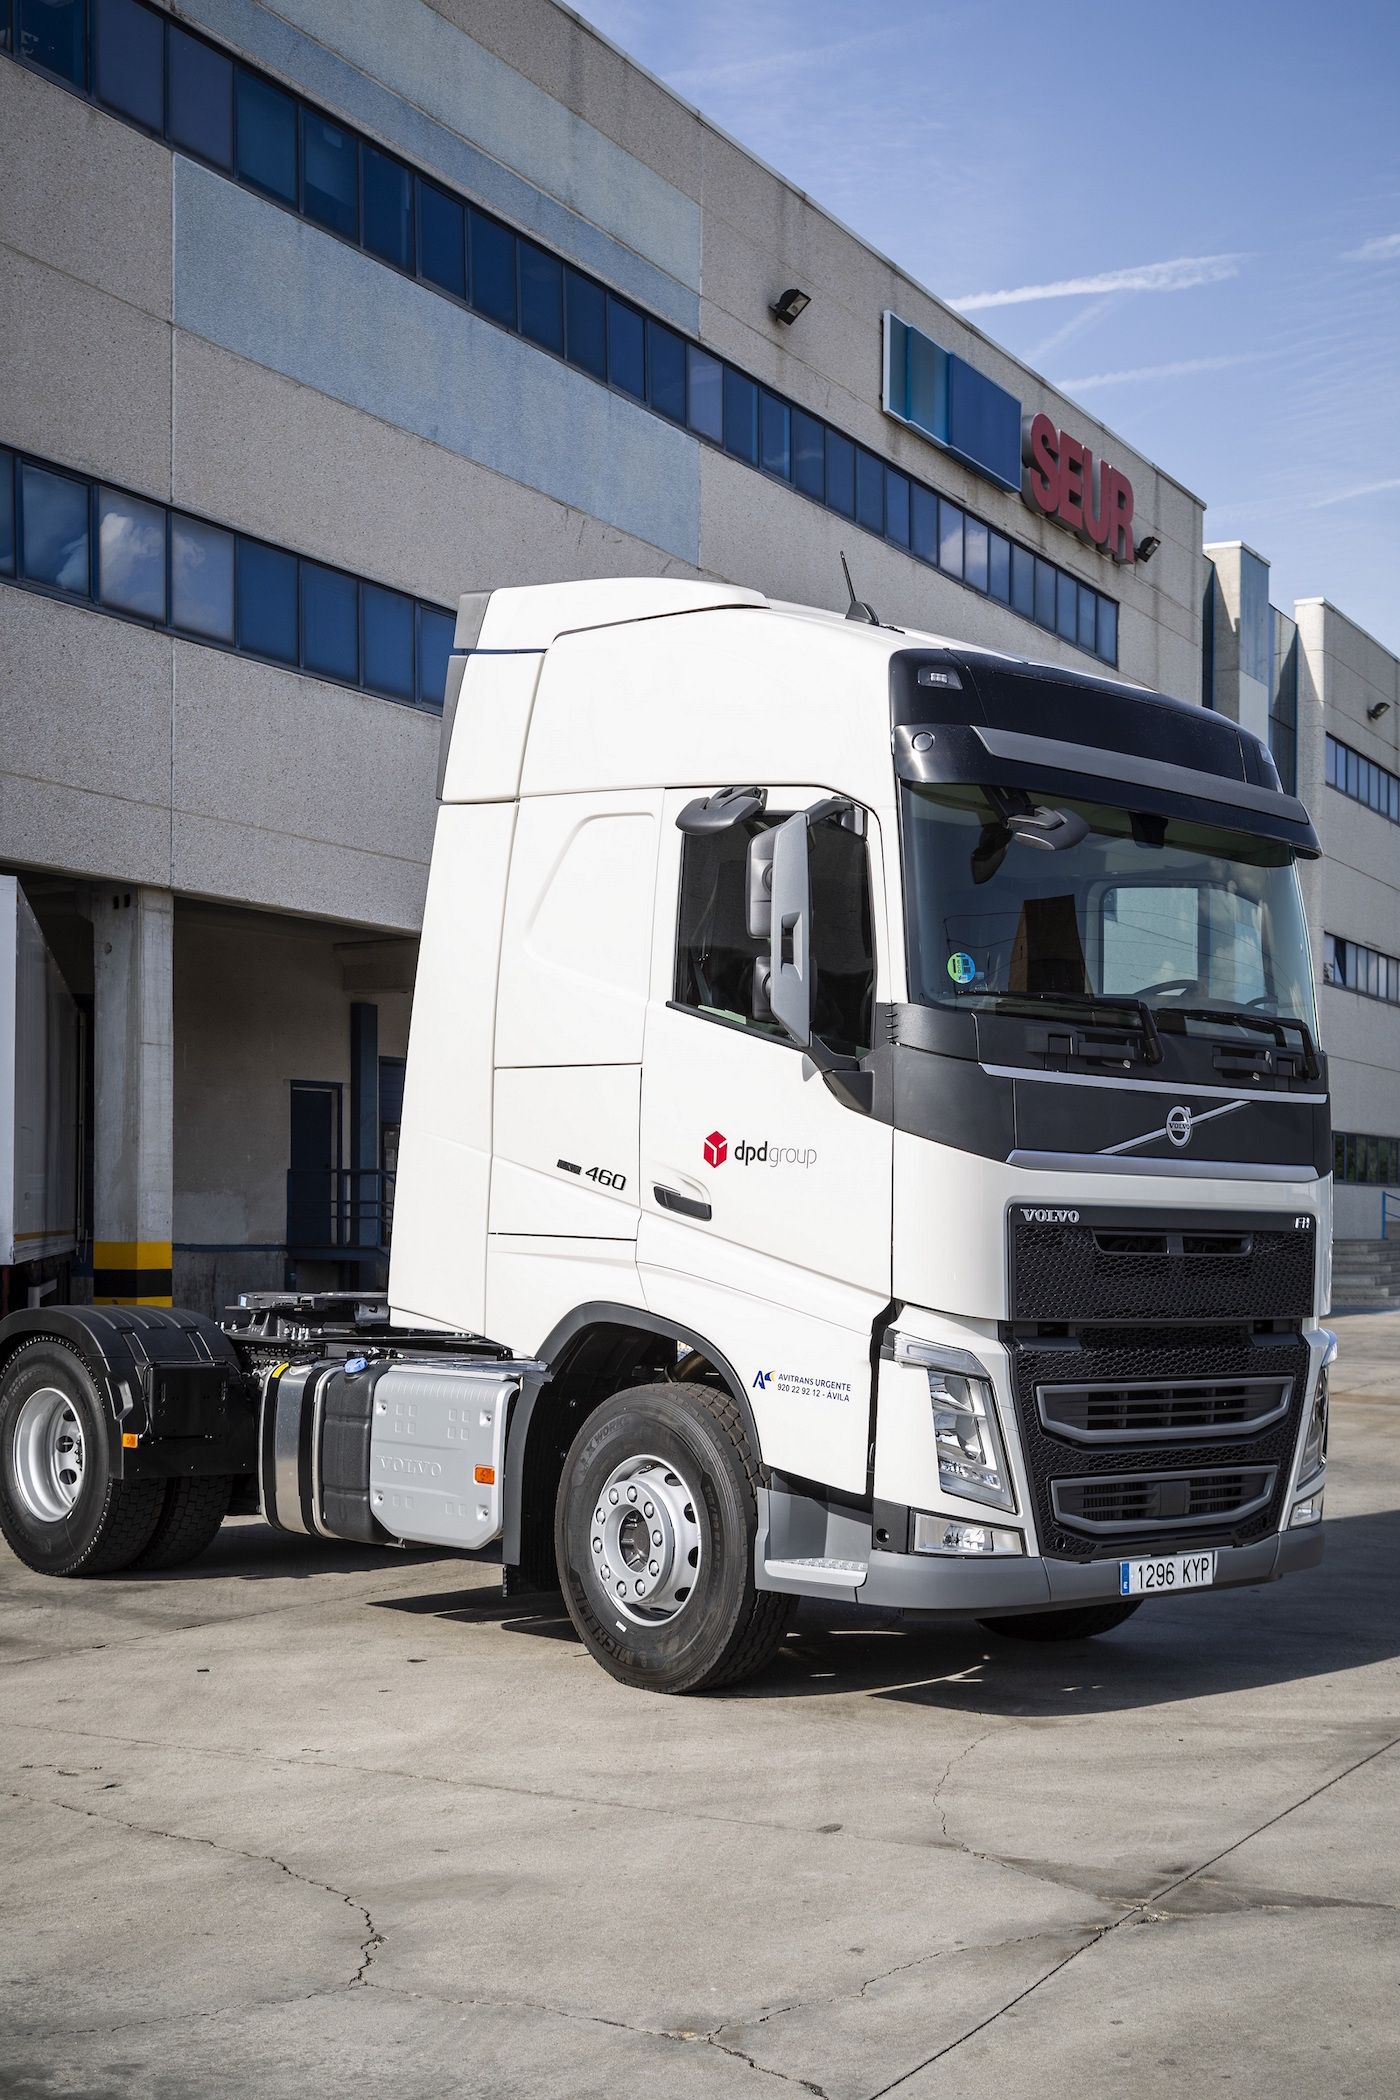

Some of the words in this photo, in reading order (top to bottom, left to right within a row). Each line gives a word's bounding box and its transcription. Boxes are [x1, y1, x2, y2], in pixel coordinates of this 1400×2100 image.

[1029, 412, 1135, 565] SEUR
[1168, 1122, 1190, 1131] VOLVO
[734, 1139, 818, 1169] dpdgroup
[585, 1166, 627, 1191] 460
[1020, 1208, 1080, 1224] VOLVO
[1294, 1217, 1310, 1229] FH
[777, 1383, 790, 1392] 920
[791, 1385, 801, 1394] 22
[801, 1387, 810, 1396] 92
[812, 1389, 821, 1398] 12
[778, 1373, 814, 1386] AVITRANS
[815, 1378, 852, 1392] URGENTE
[376, 1455, 442, 1477] VOLVO
[1138, 1561, 1175, 1589] 1296
[1182, 1557, 1210, 1583] KYP
